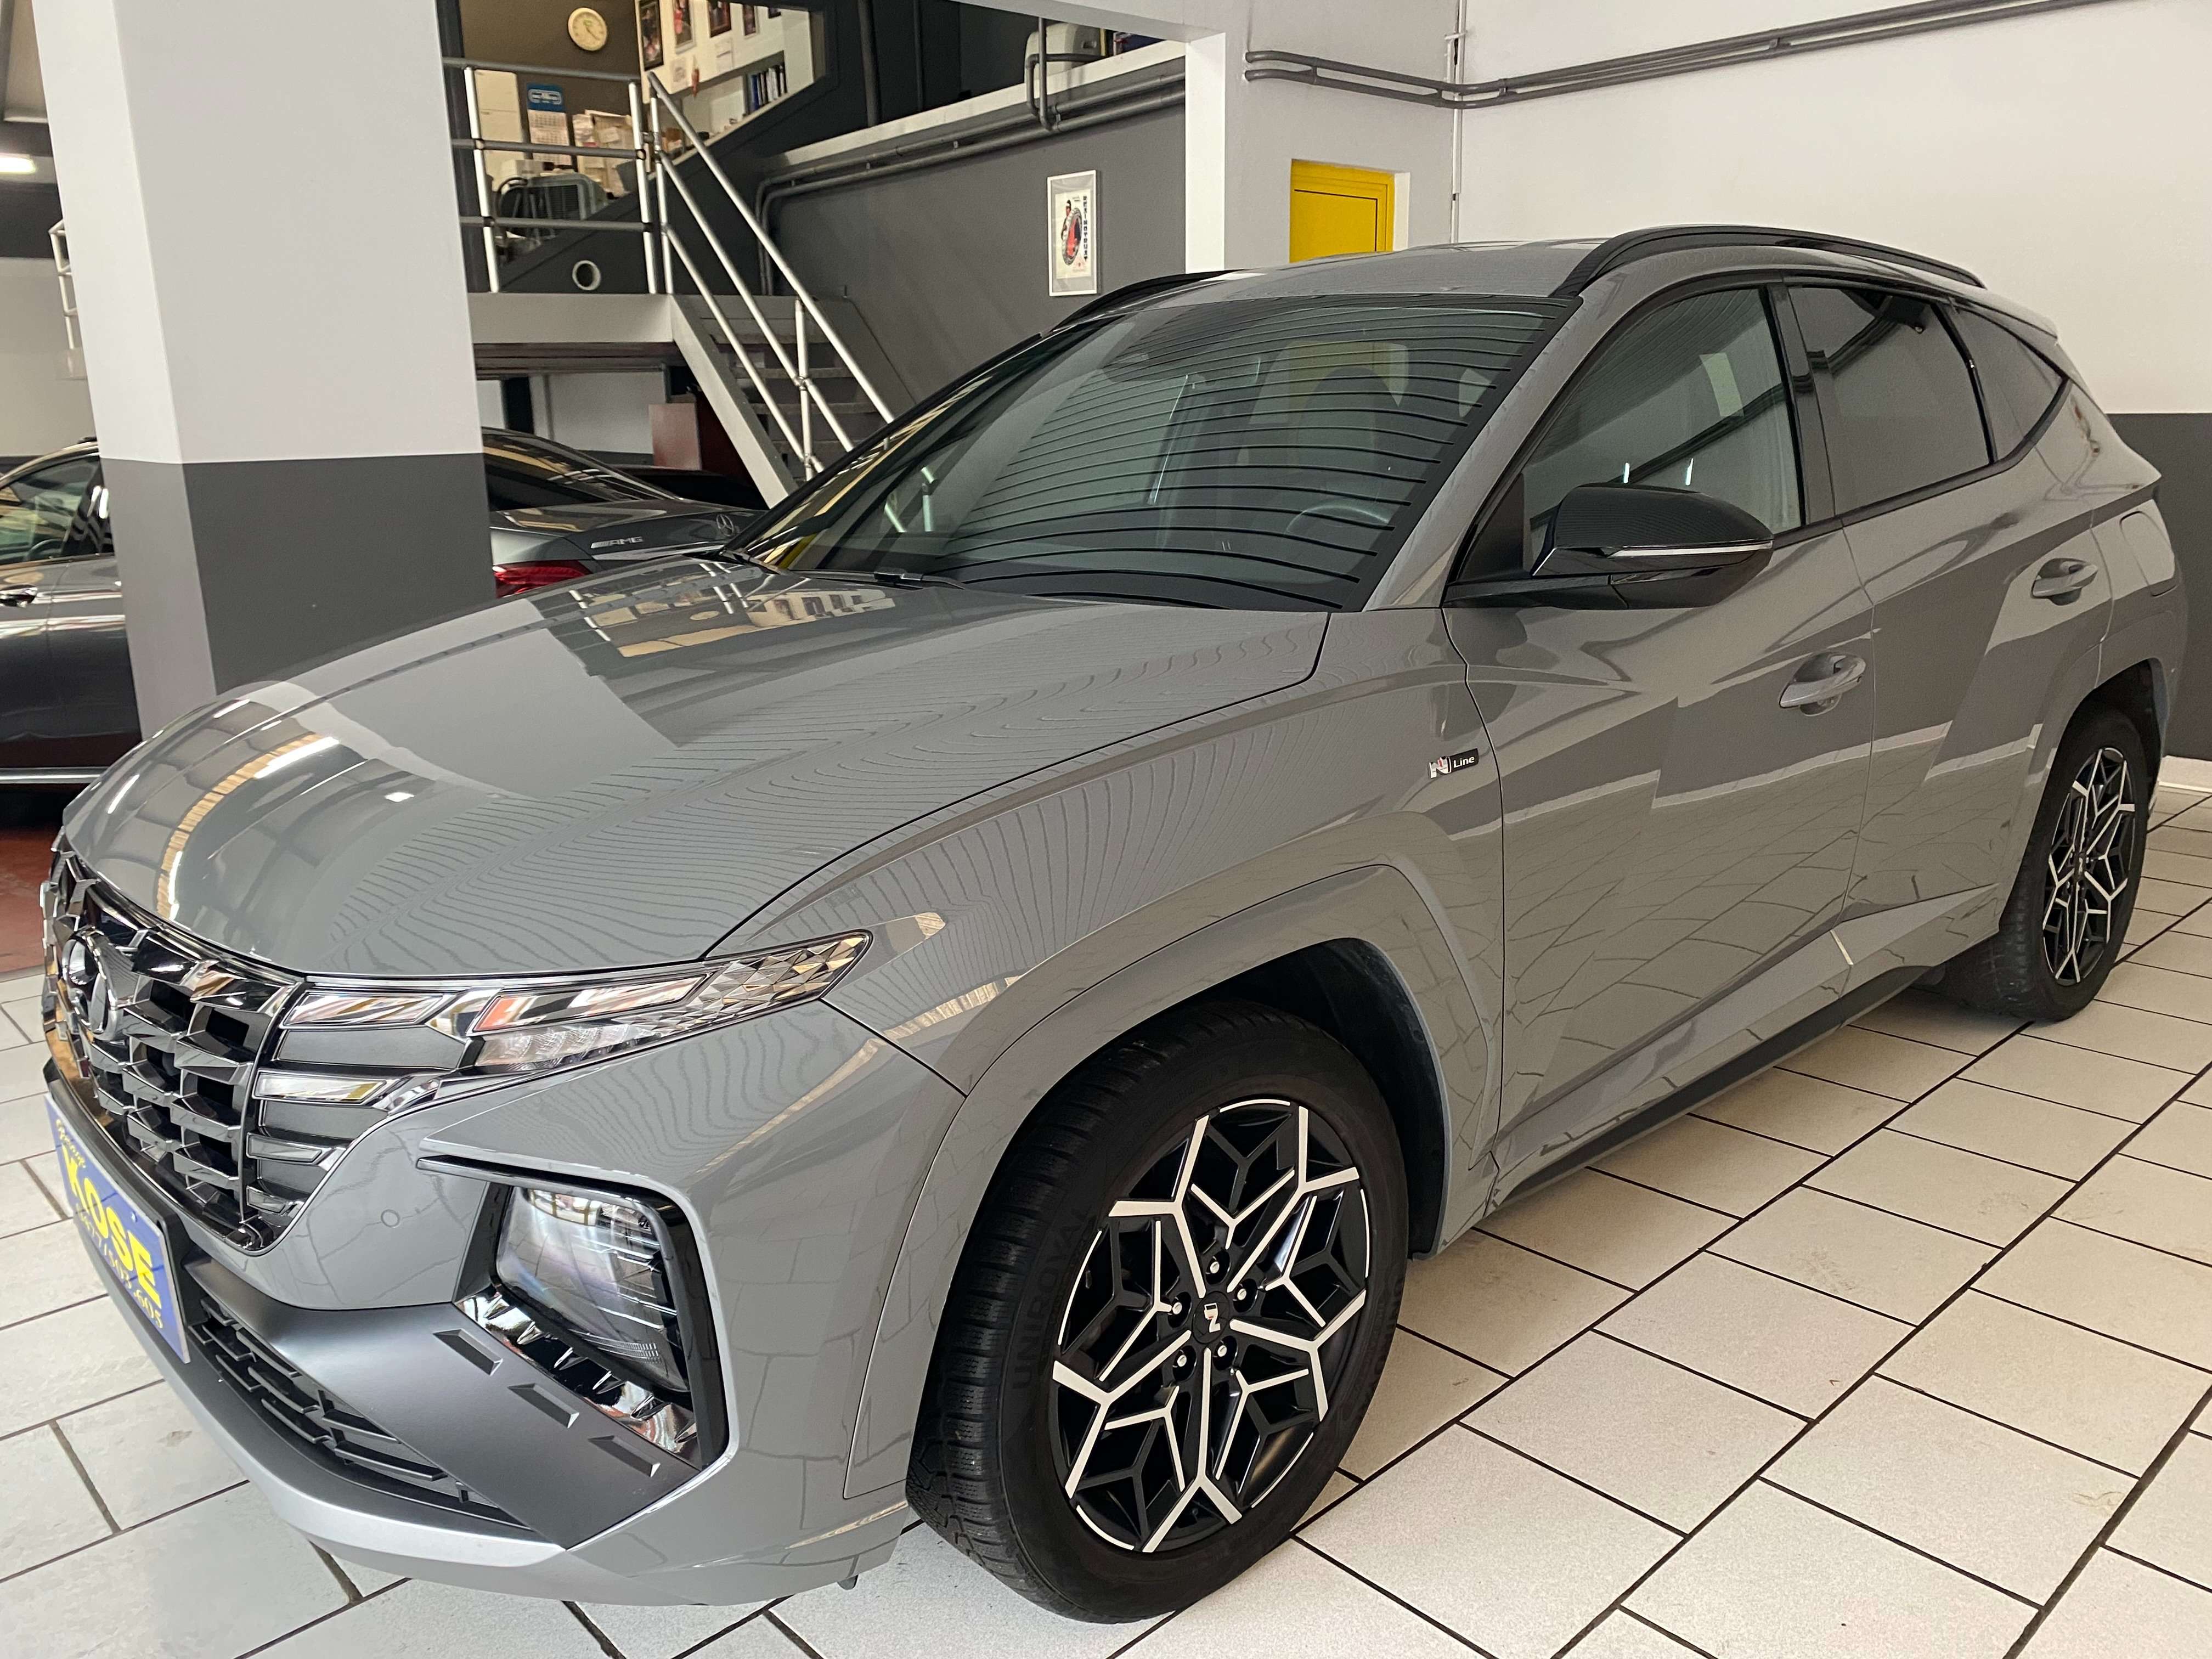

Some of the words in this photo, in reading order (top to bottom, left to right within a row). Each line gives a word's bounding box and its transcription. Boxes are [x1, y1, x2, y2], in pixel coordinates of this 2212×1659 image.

[609, 536, 644, 547] AMG
[1429, 757, 1449, 778] N
[1453, 757, 1475, 768] Line
[61, 1143, 162, 1309] KOSE
[1012, 1205, 1091, 1390] UNIROYAL
